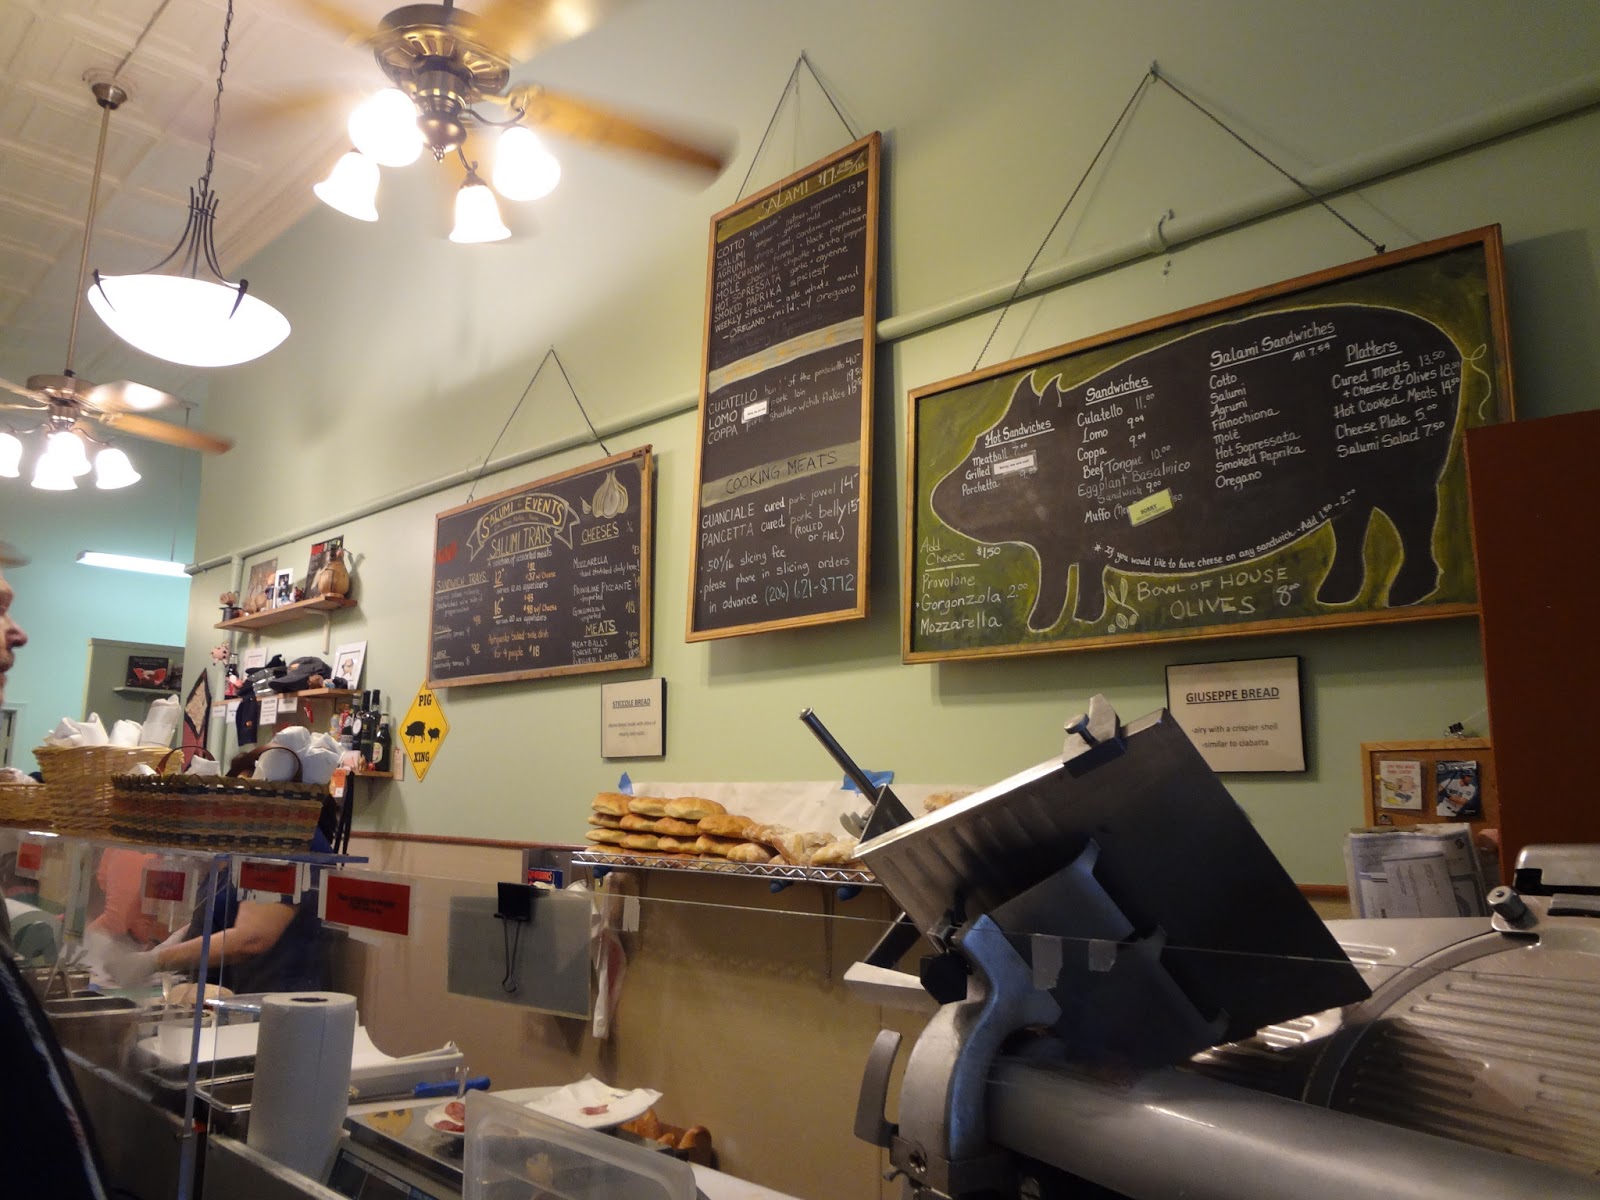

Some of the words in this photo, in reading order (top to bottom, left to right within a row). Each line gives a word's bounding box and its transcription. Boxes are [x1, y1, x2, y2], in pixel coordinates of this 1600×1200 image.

[761, 179, 809, 214] SALAMI
[716, 238, 745, 259] COTTO
[717, 260, 746, 280] AGRUMI
[718, 250, 746, 270] SALUMI
[715, 281, 741, 301] MOLE
[715, 313, 743, 333] WEEKLY
[745, 301, 775, 319] SPECIAL
[837, 265, 859, 282] avail
[816, 285, 856, 303] oregano
[714, 303, 743, 323] SMOKED
[746, 284, 782, 307] PAPRIKA
[714, 298, 729, 313] HOT
[1210, 341, 1259, 368] Salami
[1261, 321, 1336, 352] Sandwiches
[1345, 340, 1398, 362] Platters
[1291, 350, 1306, 362] All
[1209, 372, 1238, 390] Cotto
[1332, 369, 1369, 389] Cured
[1371, 360, 1411, 379] Meats
[1352, 381, 1390, 397] Cheese
[1392, 375, 1405, 390] &
[1405, 369, 1438, 385] Olives
[708, 389, 758, 415] CULATELLO
[788, 375, 797, 387] of
[1086, 374, 1150, 403] Sandwiches
[1210, 383, 1247, 404] Salumi
[1210, 398, 1248, 421] Agrumi
[1334, 402, 1356, 419] Hot
[1359, 393, 1405, 413] Cooked
[1407, 386, 1438, 402] Meats
[708, 410, 738, 431] LOMO
[1077, 404, 1124, 427] Culatello
[1211, 408, 1280, 432] Finnochiona
[1335, 422, 1378, 440] Cheese
[1378, 413, 1411, 429] Plate
[707, 424, 739, 445] COPPA
[984, 429, 1002, 447] Hot
[1002, 419, 1052, 441] Sandwiches
[1082, 427, 1109, 444] Lomo
[1336, 435, 1380, 458] Salumi
[1381, 426, 1421, 448] Salad
[972, 447, 1008, 466] Meatball
[1076, 447, 1107, 466] Coppa
[1215, 445, 1235, 460] Hot
[1235, 431, 1301, 458] Sopressata
[1083, 460, 1104, 480] Beef
[1103, 455, 1144, 473] Tongue
[1215, 455, 1257, 473] Smoked
[1260, 445, 1306, 466] Paprika
[725, 466, 780, 495] COOKING
[787, 451, 838, 475] MEATS
[965, 465, 991, 480] Grilled
[1077, 473, 1127, 499] Eggplant
[1132, 461, 1191, 483] Basalmico
[1215, 470, 1262, 491] Oregano
[961, 479, 1000, 496] Porchetta
[1097, 485, 1143, 504] Sandwich
[481, 501, 514, 539] SALUMI
[525, 496, 565, 526] EVENTS
[702, 502, 755, 530] GUANCIALE
[764, 496, 785, 513] cured
[788, 493, 806, 514] pork
[1084, 508, 1111, 524] Muffo
[581, 521, 620, 543] CHEESES
[701, 522, 754, 549] PANCETTA
[760, 514, 786, 532] cured
[789, 508, 813, 535] pork
[818, 498, 847, 524] belly
[523, 524, 552, 548] TRAYS
[808, 532, 819, 542] or
[920, 536, 941, 553] Add
[740, 550, 767, 567] slicing
[772, 545, 787, 558] fee
[925, 552, 966, 566] Cheese
[1116, 551, 1129, 564] you
[1131, 556, 1151, 566] would
[1154, 555, 1167, 567] like
[1168, 559, 1177, 569] to
[1178, 557, 1196, 569] have
[1197, 554, 1223, 568] cheese
[1225, 554, 1237, 562] on
[1238, 548, 1256, 562] any
[1256, 531, 1295, 553] sandwich
[735, 573, 756, 591] phone
[762, 568, 770, 579] in
[776, 560, 810, 576] slicing
[818, 556, 850, 569] orders
[922, 571, 976, 593] Provolone
[1136, 581, 1186, 601] BOWL
[1220, 567, 1288, 590] HOUSE
[709, 601, 717, 614] in
[722, 593, 758, 610] advance
[764, 580, 789, 606] (206)
[921, 585, 1002, 616] Gorgonzola
[1170, 595, 1256, 620] OLIVES
[585, 619, 617, 636] MEATS
[920, 611, 1003, 636] Mozzarella
[418, 694, 432, 706] PIG
[634, 698, 651, 707] BREAD
[1186, 689, 1238, 703] GIUSEPPE
[1241, 687, 1280, 699] BREAD
[1208, 723, 1224, 733] with
[1232, 724, 1258, 735] crispier
[1260, 722, 1278, 731] shell
[1202, 740, 1227, 748] -similar
[1239, 739, 1269, 748] ciabatta
[413, 751, 430, 763] XING
